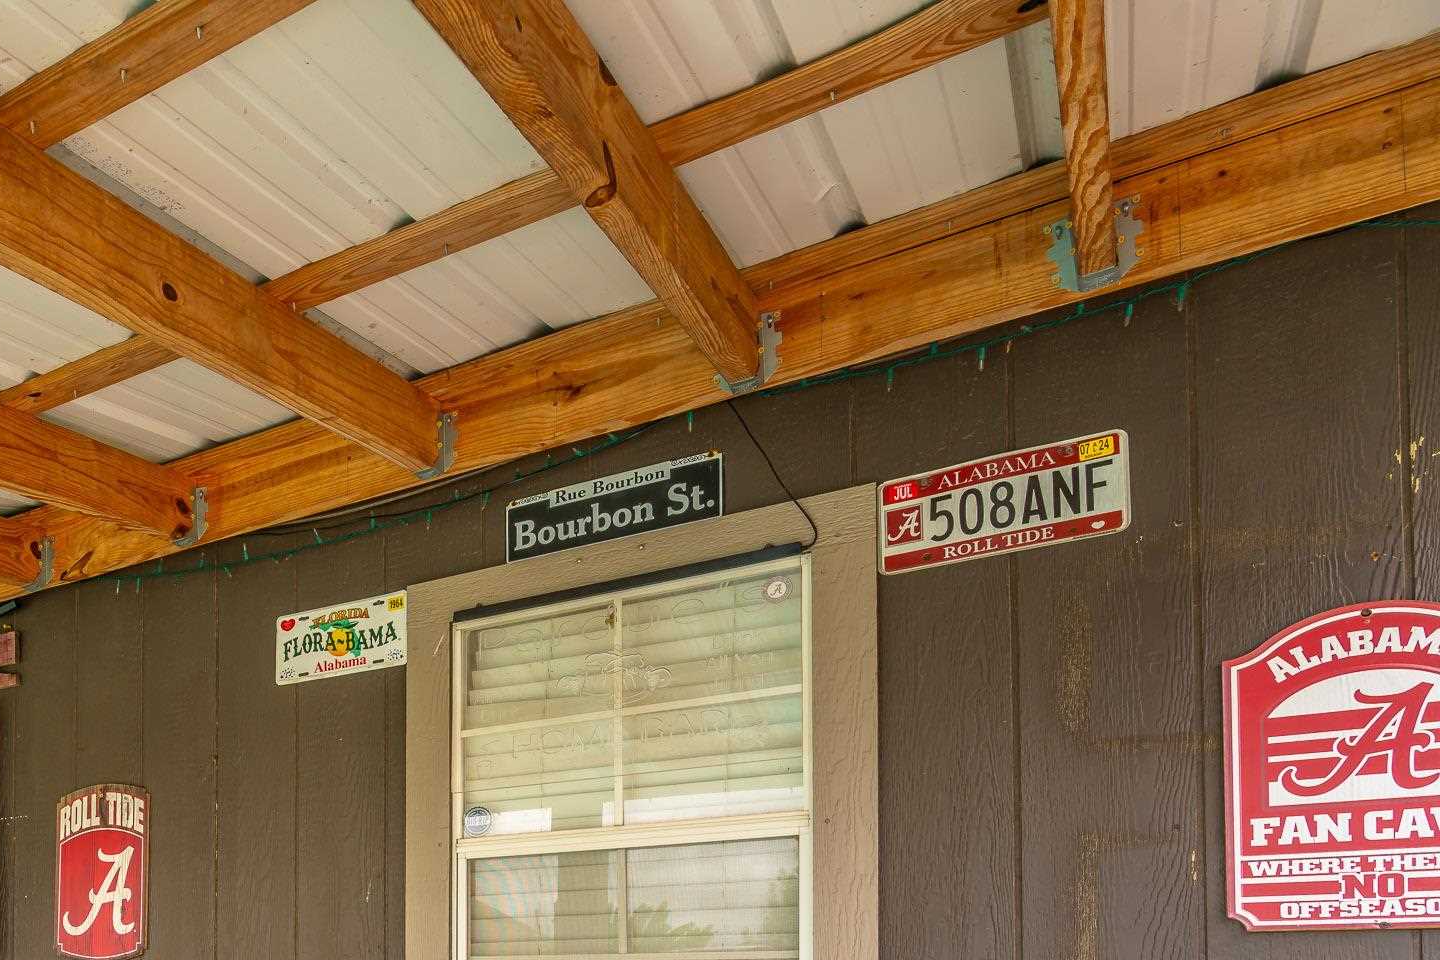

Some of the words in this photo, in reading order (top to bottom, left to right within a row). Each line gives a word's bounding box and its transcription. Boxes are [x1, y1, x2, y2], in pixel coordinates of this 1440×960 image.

[1080, 444, 1089, 455] 07
[1099, 439, 1110, 451] 24
[553, 487, 586, 505] Rue
[592, 470, 665, 495] Bourbon
[937, 451, 1056, 490] ALABAMA
[893, 483, 913, 501] JUL
[929, 459, 1114, 543] 508ANF
[513, 502, 655, 551] Bourbon
[667, 483, 715, 517] St.
[943, 538, 999, 559] ROLL
[1003, 526, 1055, 548] TIDE
[314, 656, 367, 673] Alabama
[60, 793, 101, 841] ROLL
[105, 792, 145, 833] TIDE
[1250, 812, 1353, 847] FAN
[1363, 807, 1440, 841] CA
[1248, 857, 1360, 877] WHERE
[1368, 853, 1440, 872] THE
[1341, 873, 1405, 899] NO
